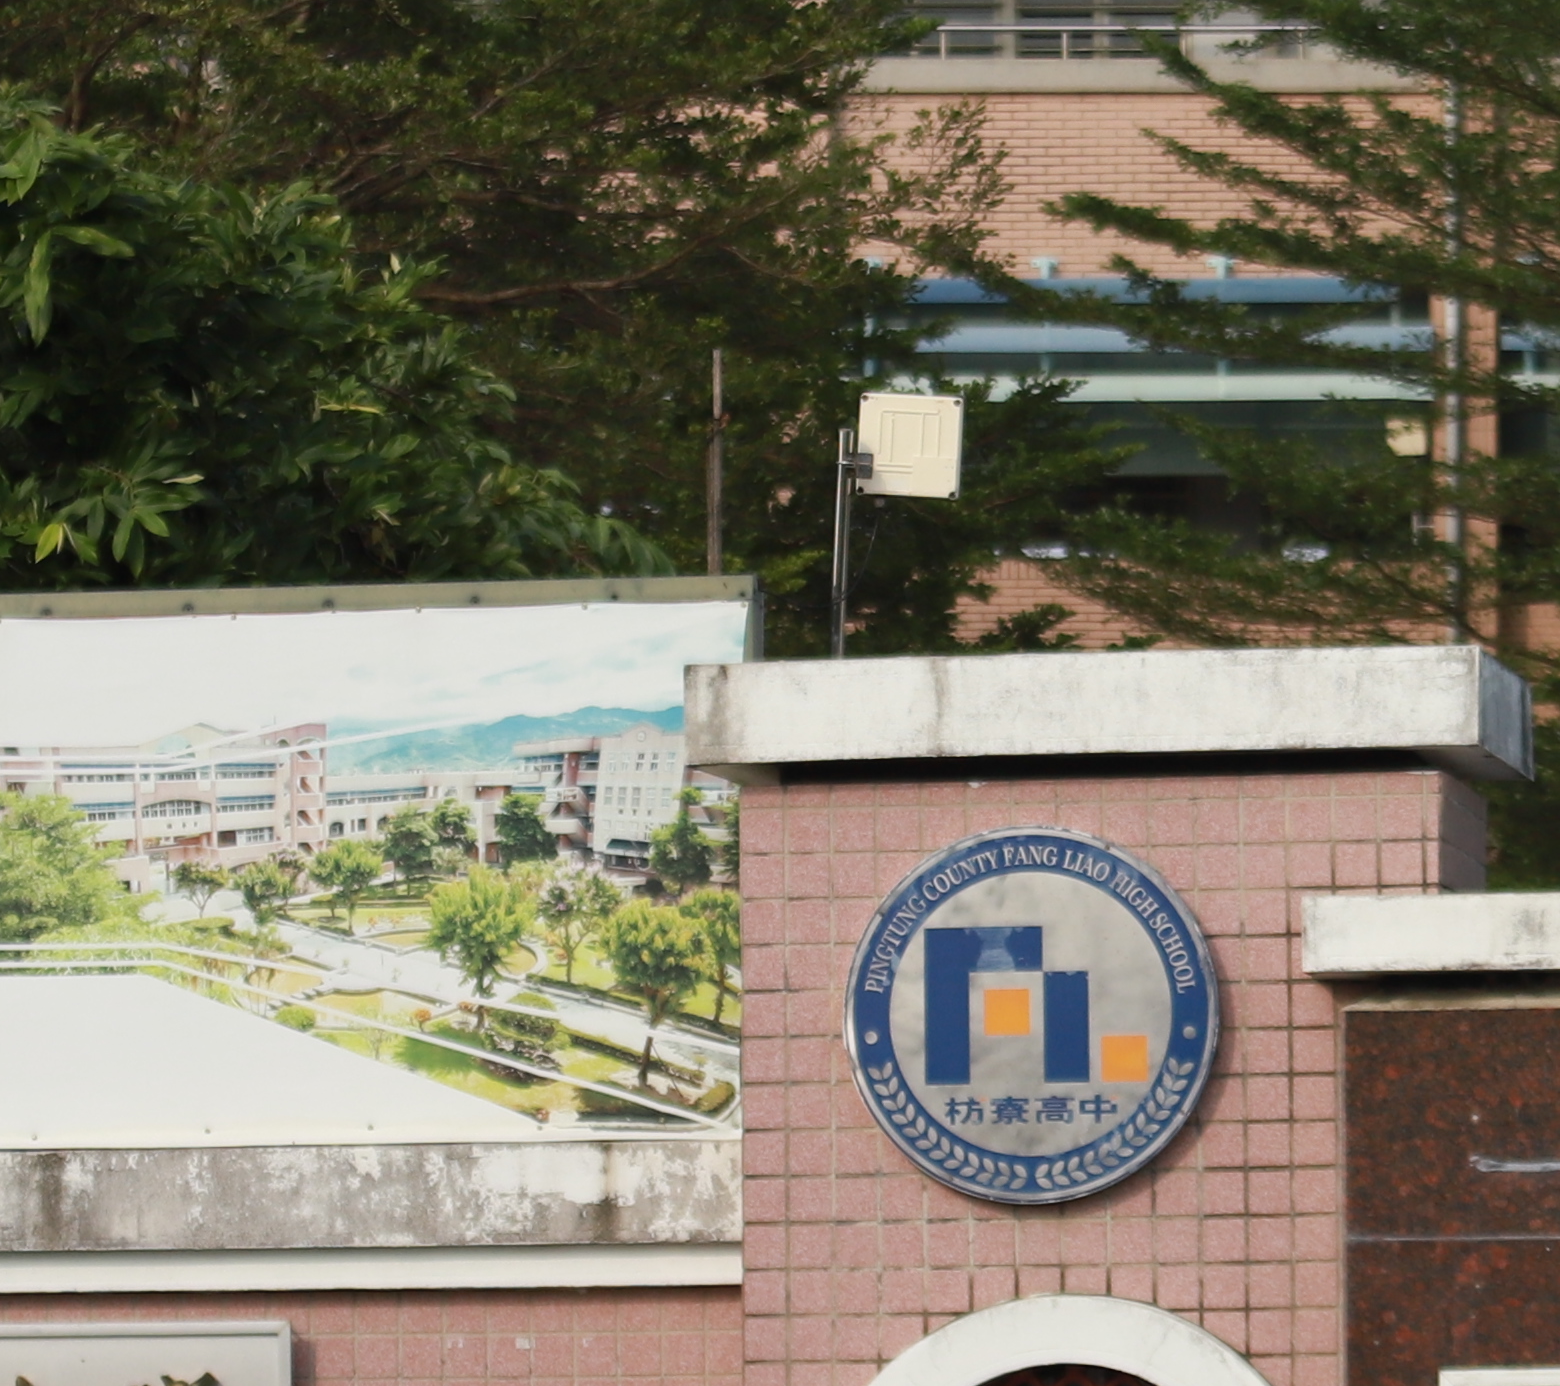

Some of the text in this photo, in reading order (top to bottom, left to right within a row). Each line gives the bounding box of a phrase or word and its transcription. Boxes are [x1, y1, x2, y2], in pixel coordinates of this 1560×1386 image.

[865, 844, 1198, 995] PINGTUNG COUNTY FANG LIAO HIGH SCHOOL
[943, 1093, 1119, 1127] 枋寮高中
